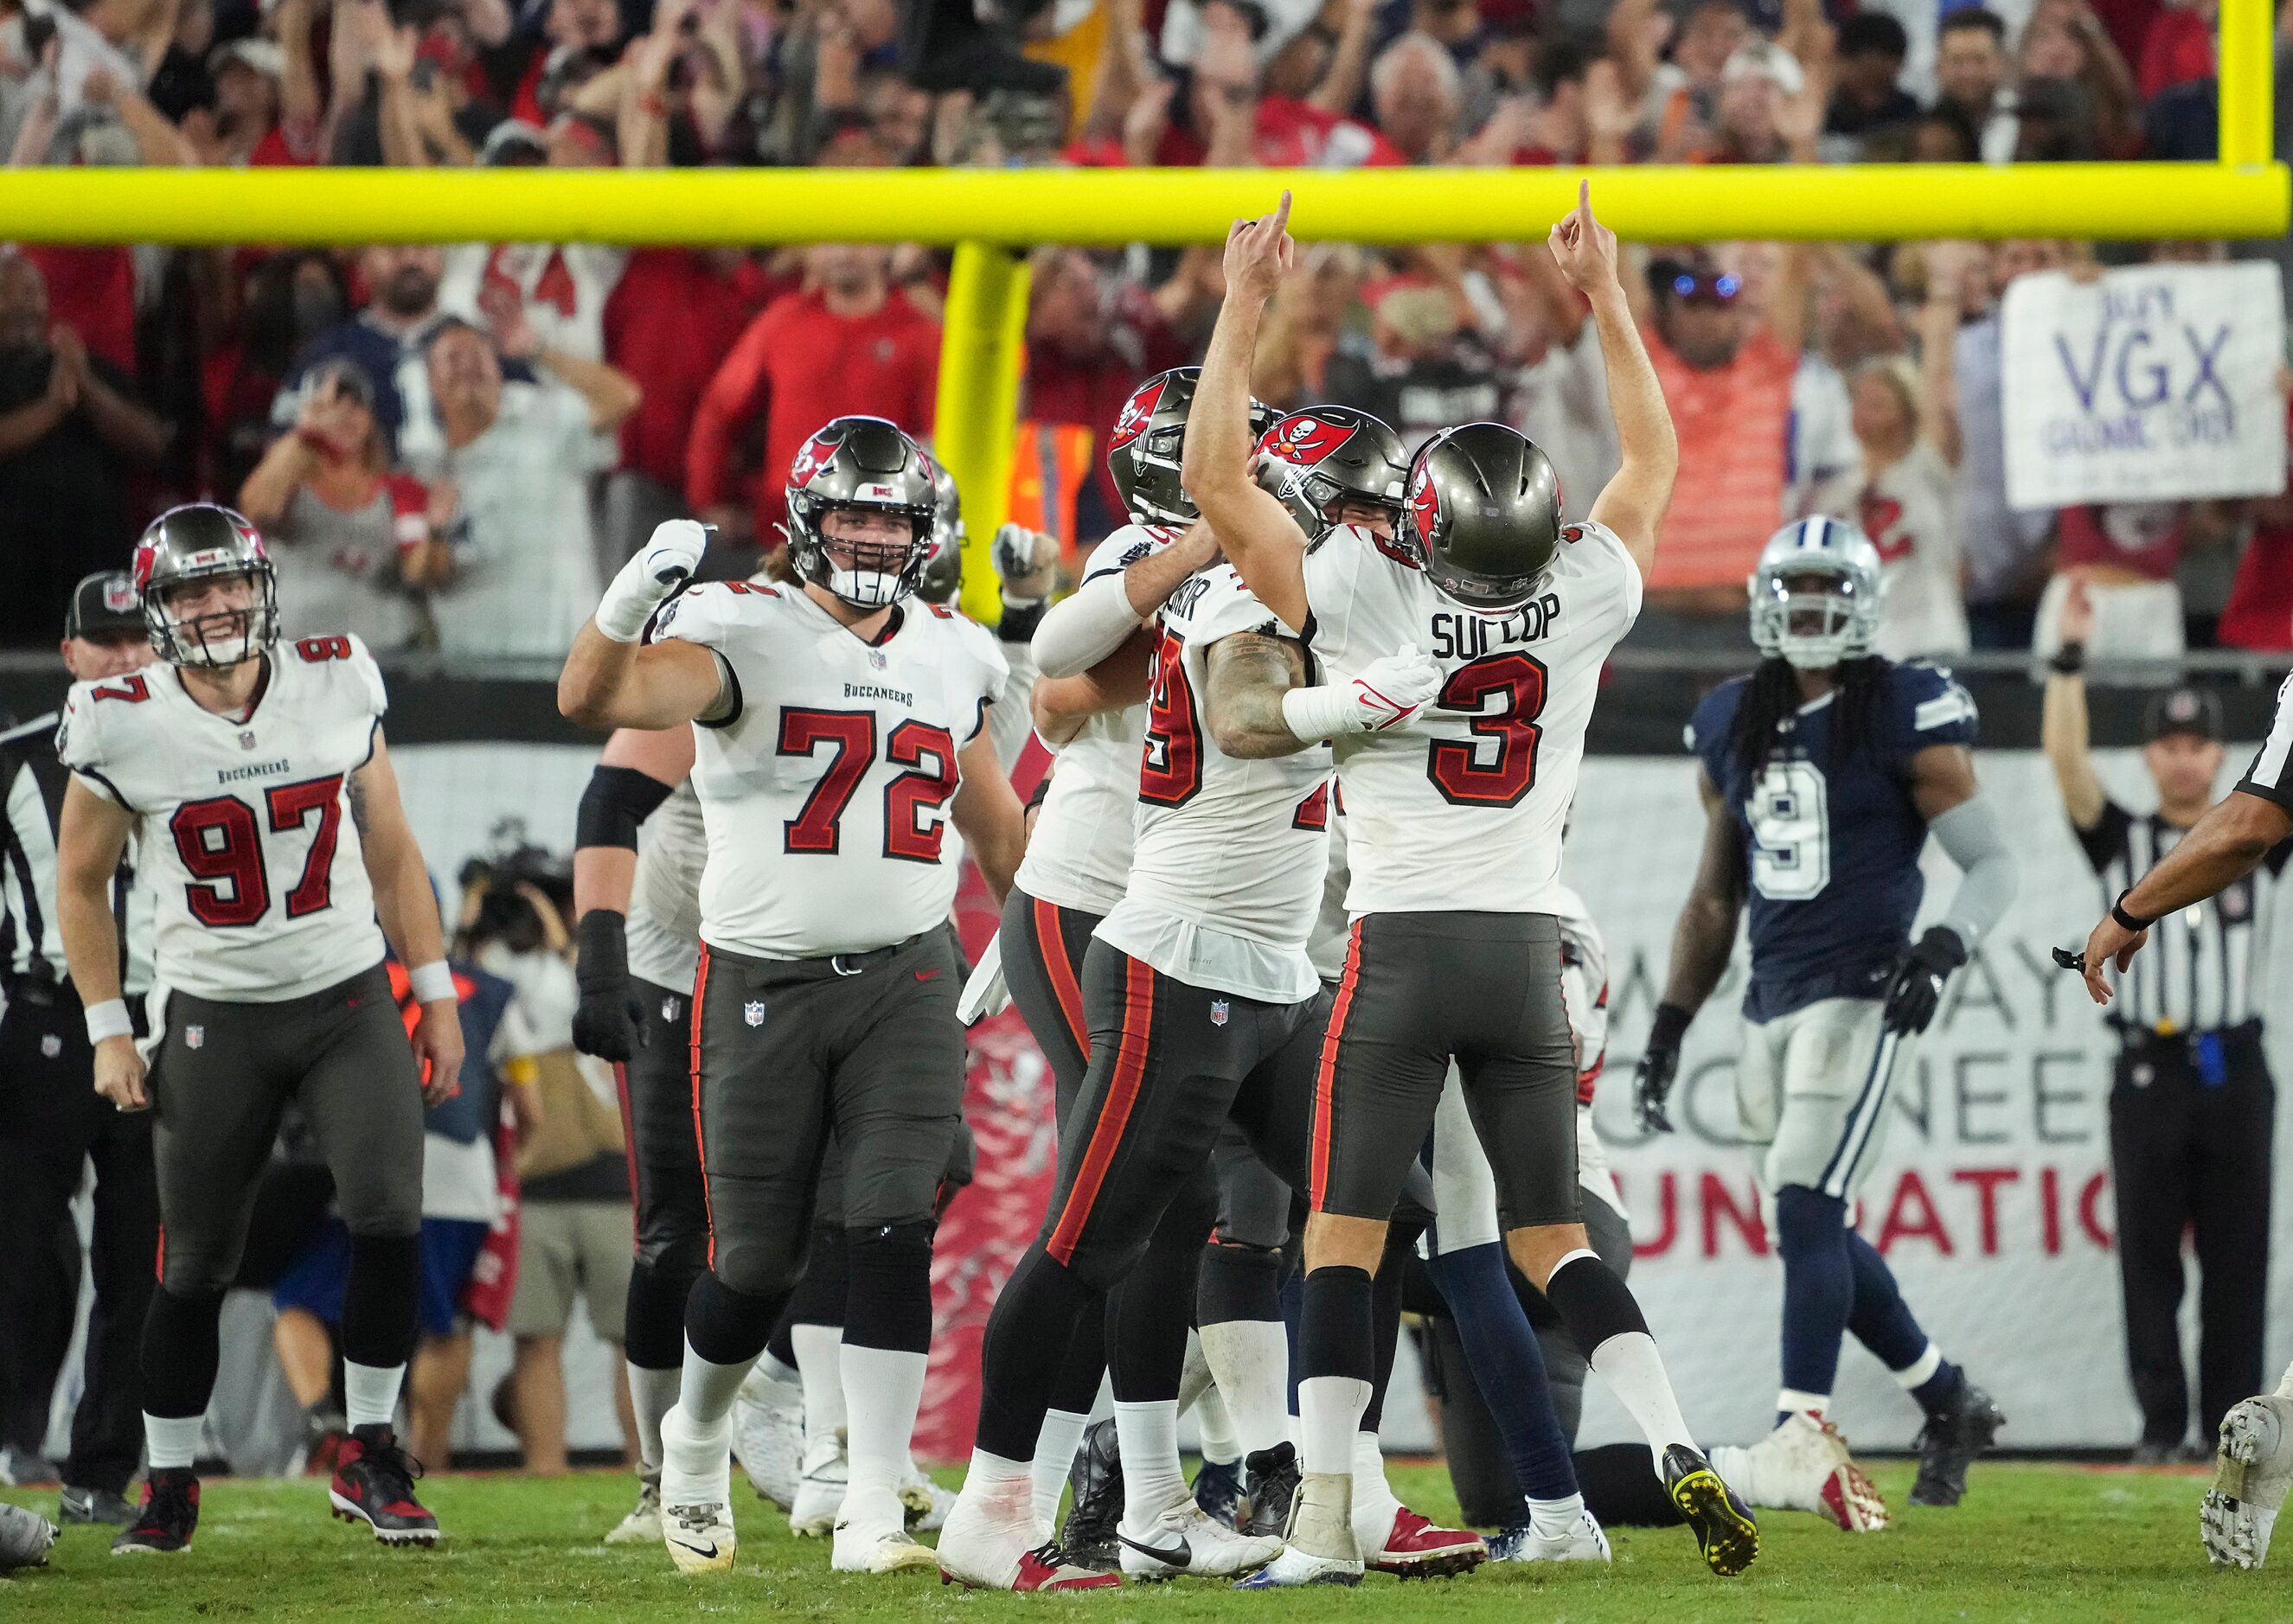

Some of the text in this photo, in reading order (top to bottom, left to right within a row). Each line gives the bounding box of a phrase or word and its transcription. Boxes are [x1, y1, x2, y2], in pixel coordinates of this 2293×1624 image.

[2053, 323, 2235, 432] VGX
[775, 706, 963, 864] 72
[1426, 649, 1548, 809] 3
[169, 771, 344, 929] 97
[1745, 761, 1831, 901] 9
